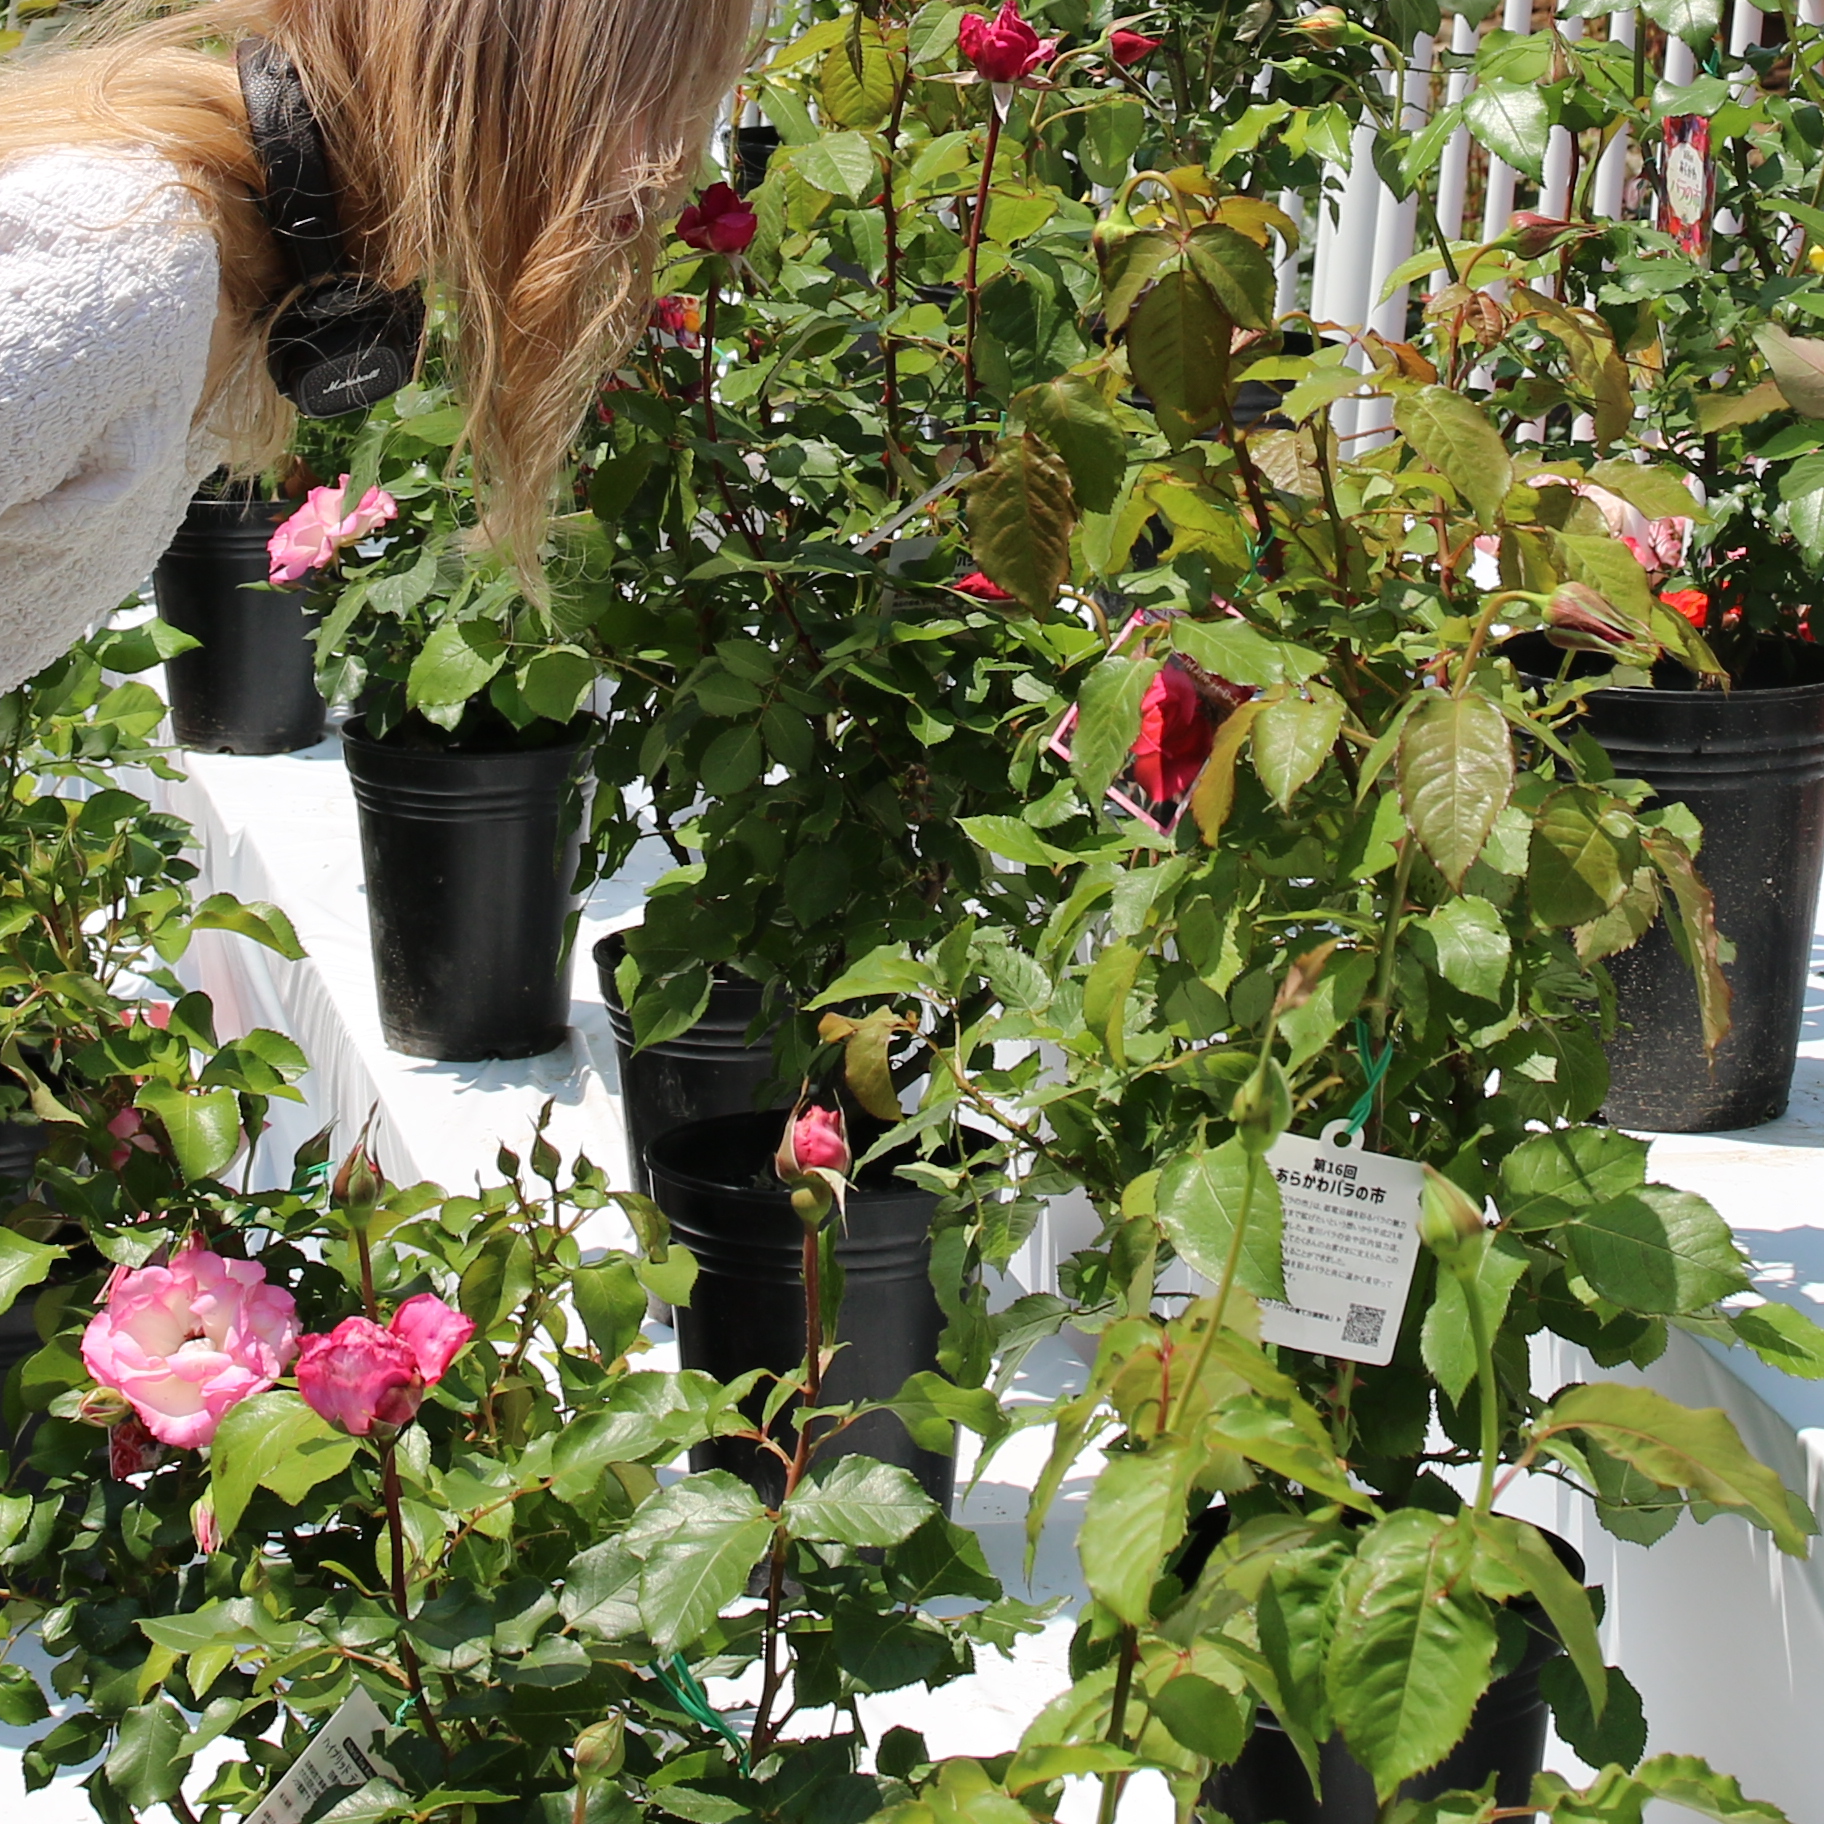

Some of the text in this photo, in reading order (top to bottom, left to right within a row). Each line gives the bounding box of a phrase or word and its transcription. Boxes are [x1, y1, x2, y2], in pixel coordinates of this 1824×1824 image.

[1276, 1167, 1387, 1205] あらかわバラの市
[1312, 1156, 1359, 1180] 第16回
[322, 1737, 353, 1775] ハイブリッド
